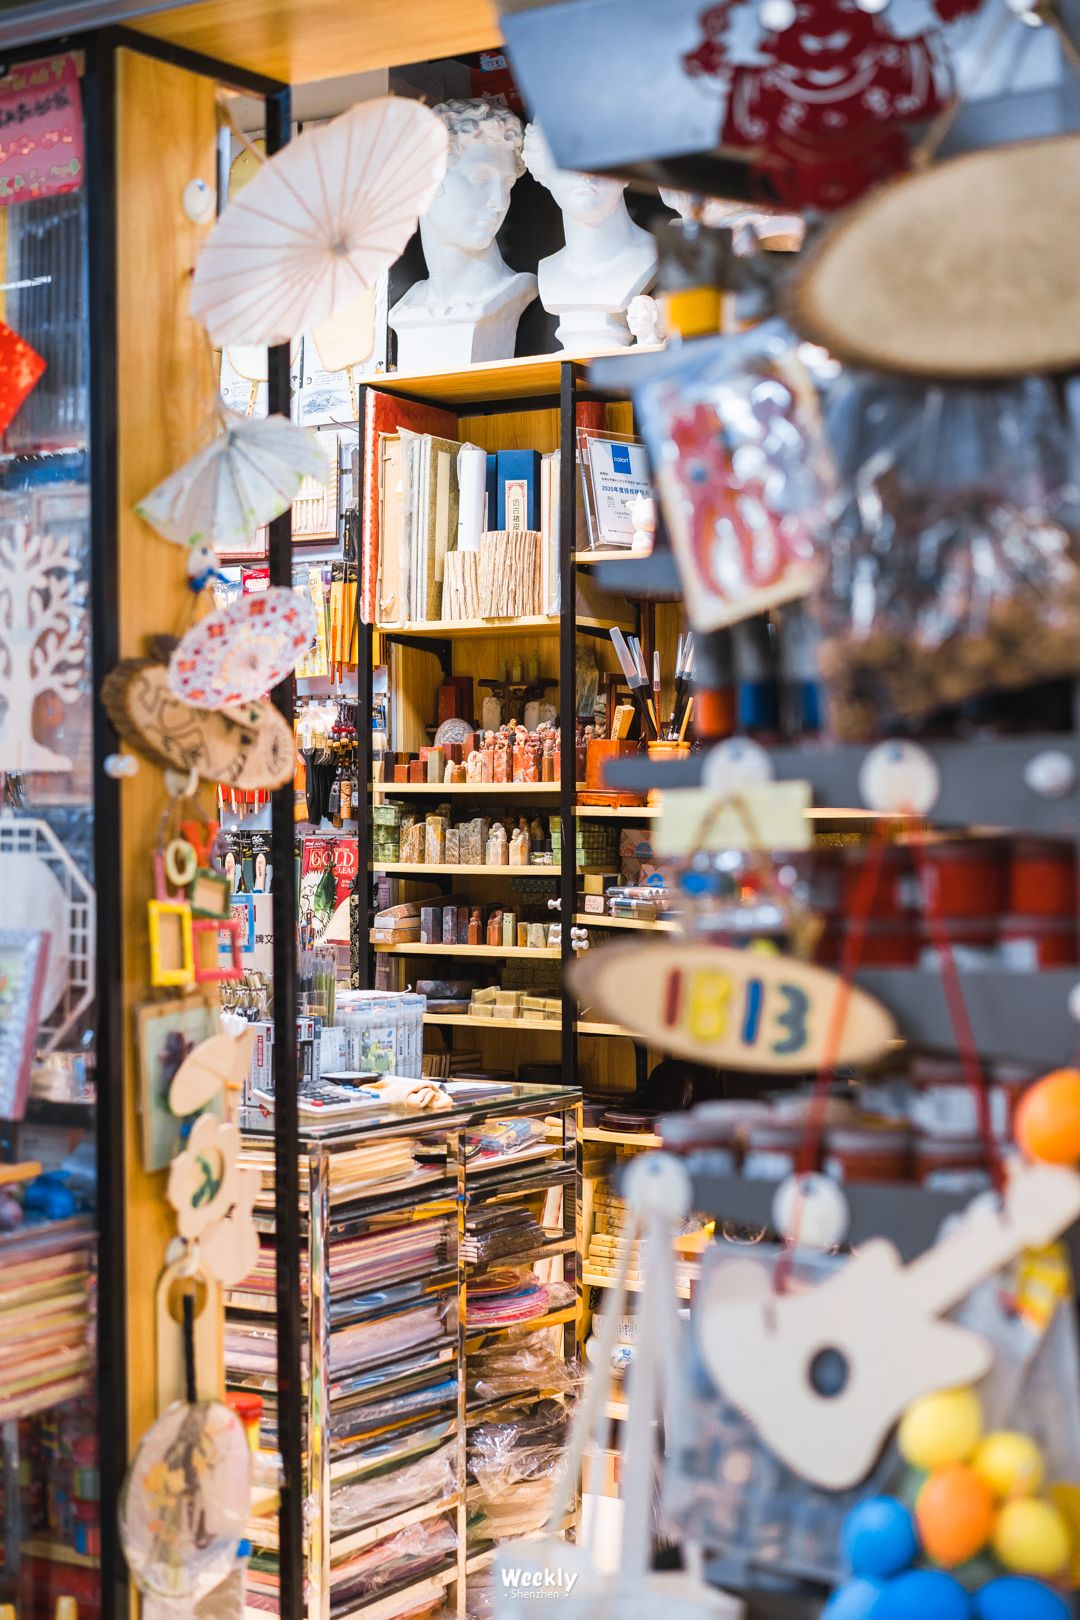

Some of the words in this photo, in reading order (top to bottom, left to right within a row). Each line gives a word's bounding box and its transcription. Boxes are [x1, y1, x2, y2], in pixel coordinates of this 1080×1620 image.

[246, 578, 270, 587] GESSO
[311, 850, 355, 867] GOLD
[337, 866, 356, 874] LEAF
